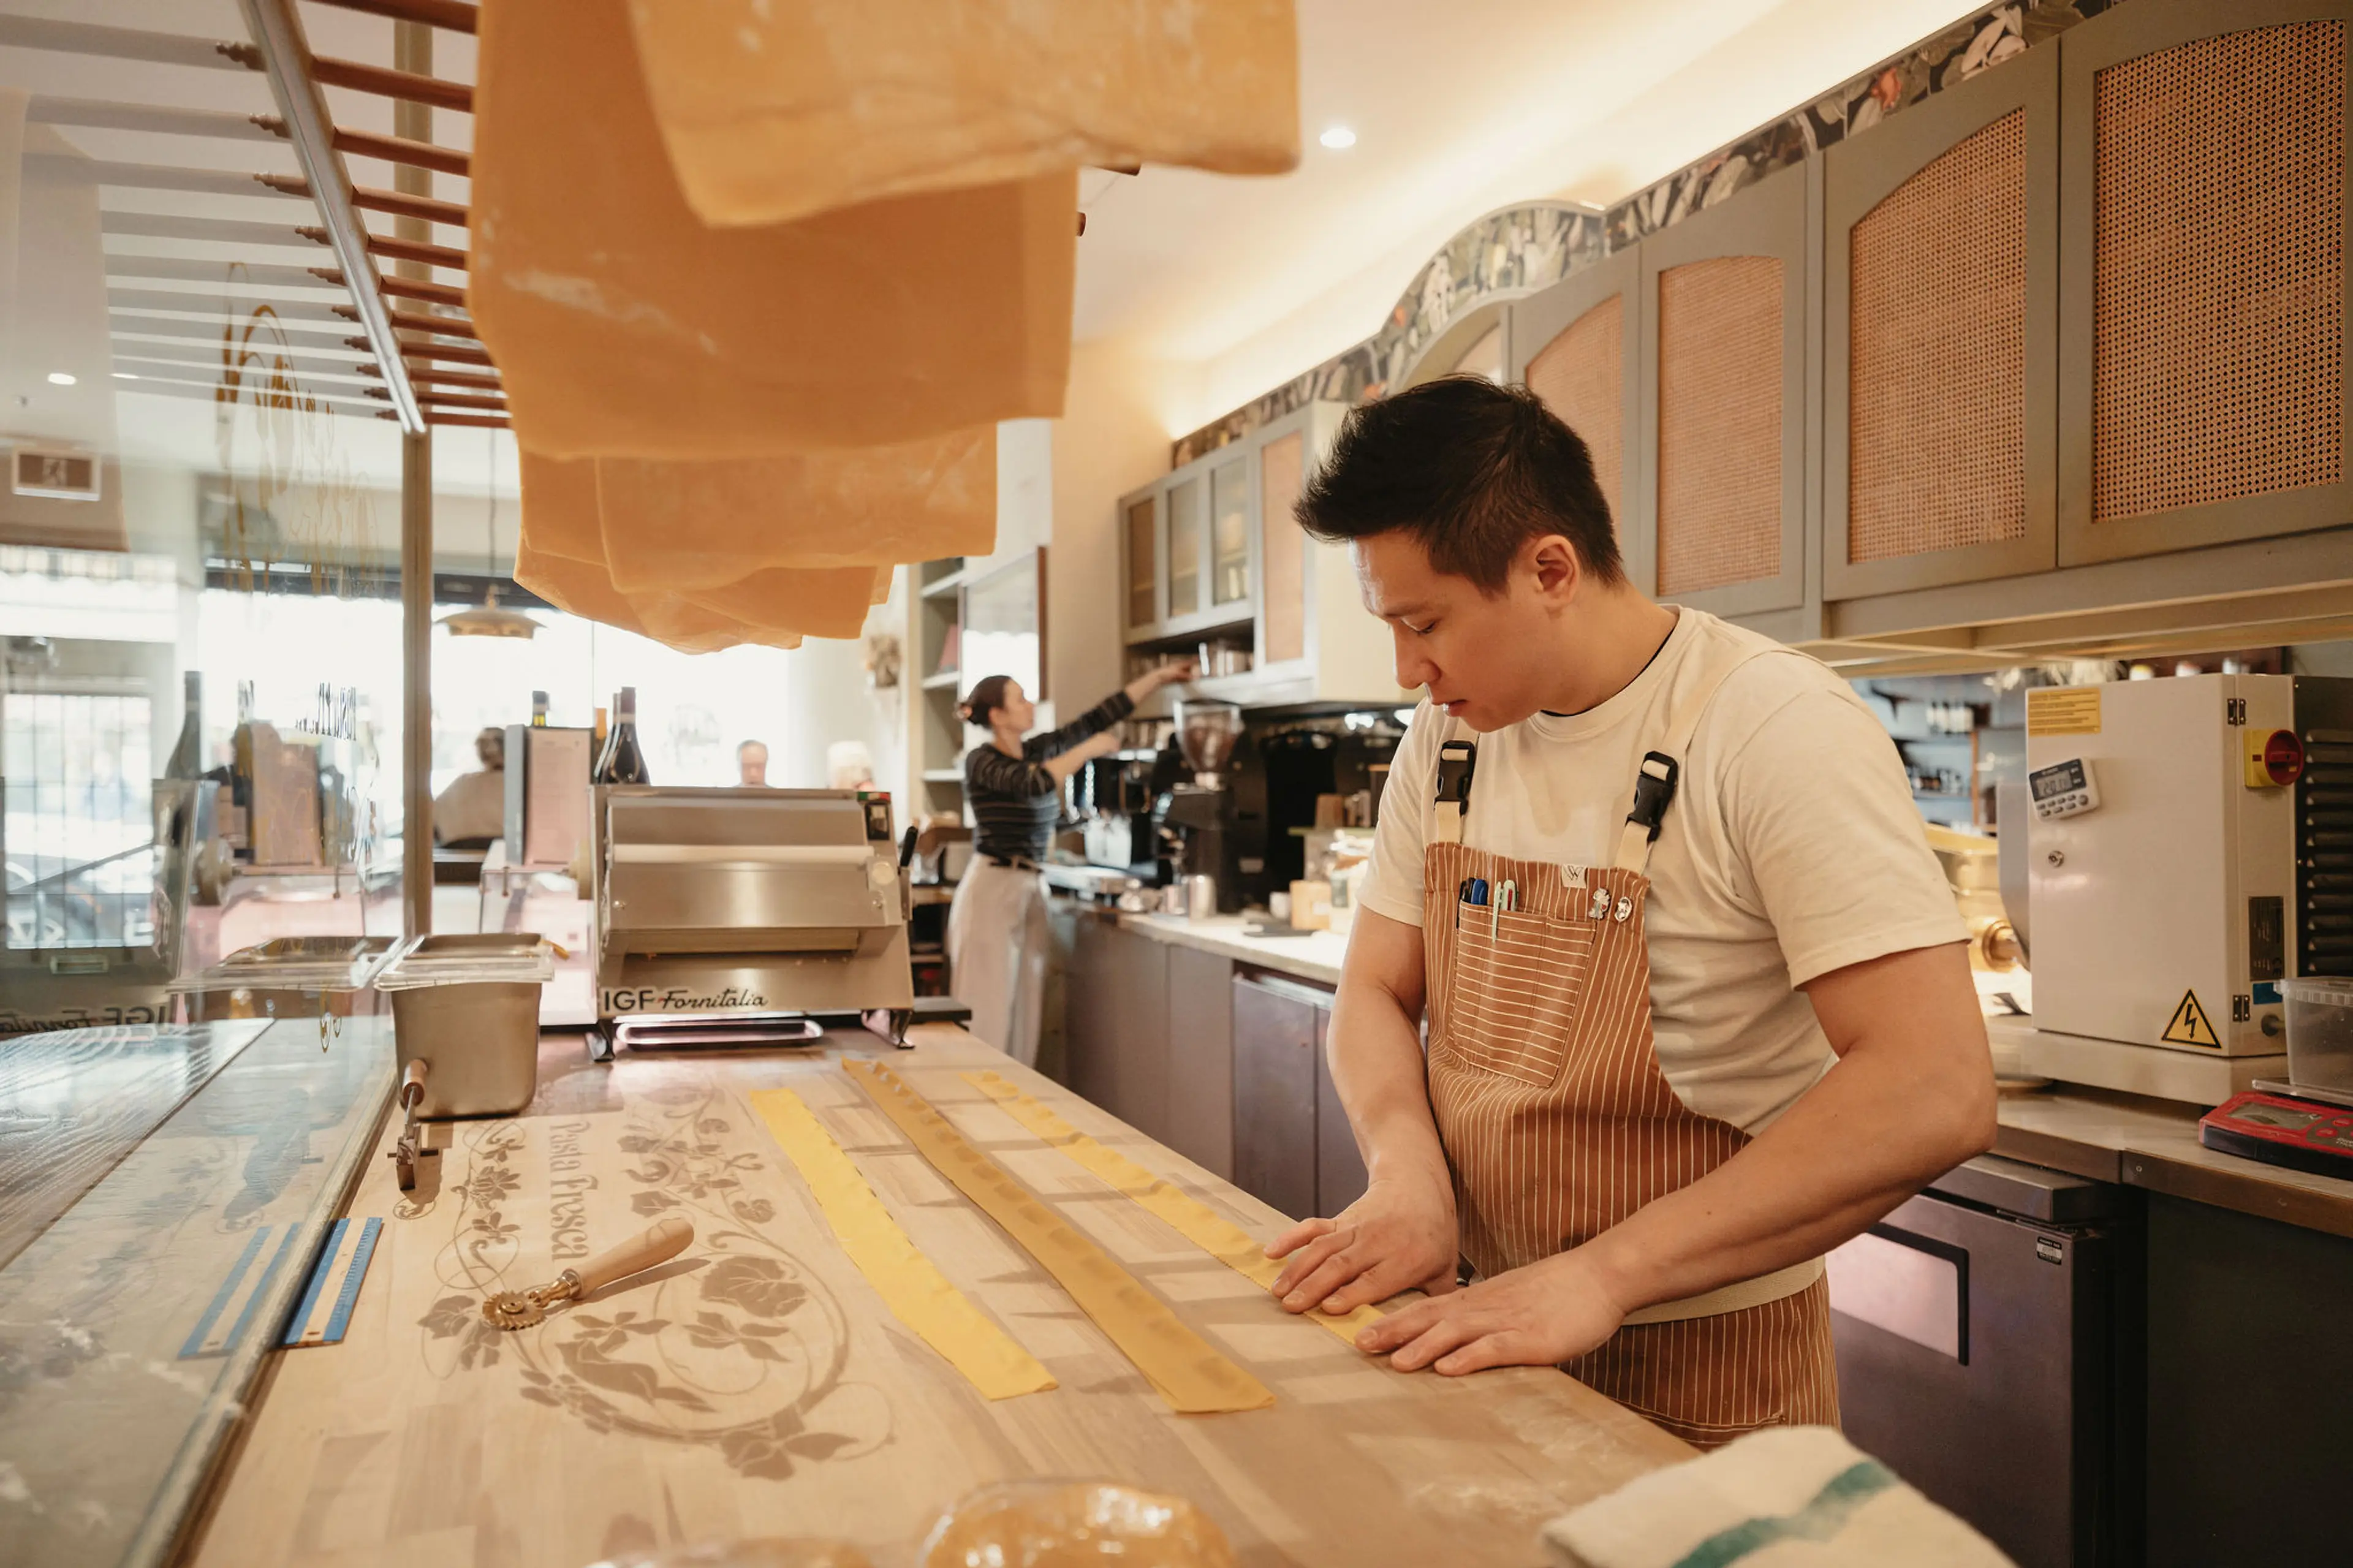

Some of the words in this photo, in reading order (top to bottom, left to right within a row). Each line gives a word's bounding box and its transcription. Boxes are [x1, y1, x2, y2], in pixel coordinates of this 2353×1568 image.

[605, 990, 654, 1011] IGF
[663, 988, 768, 1010] Fornitalia
[549, 1121, 592, 1173] Pasta
[549, 1173, 599, 1264] Fresca
